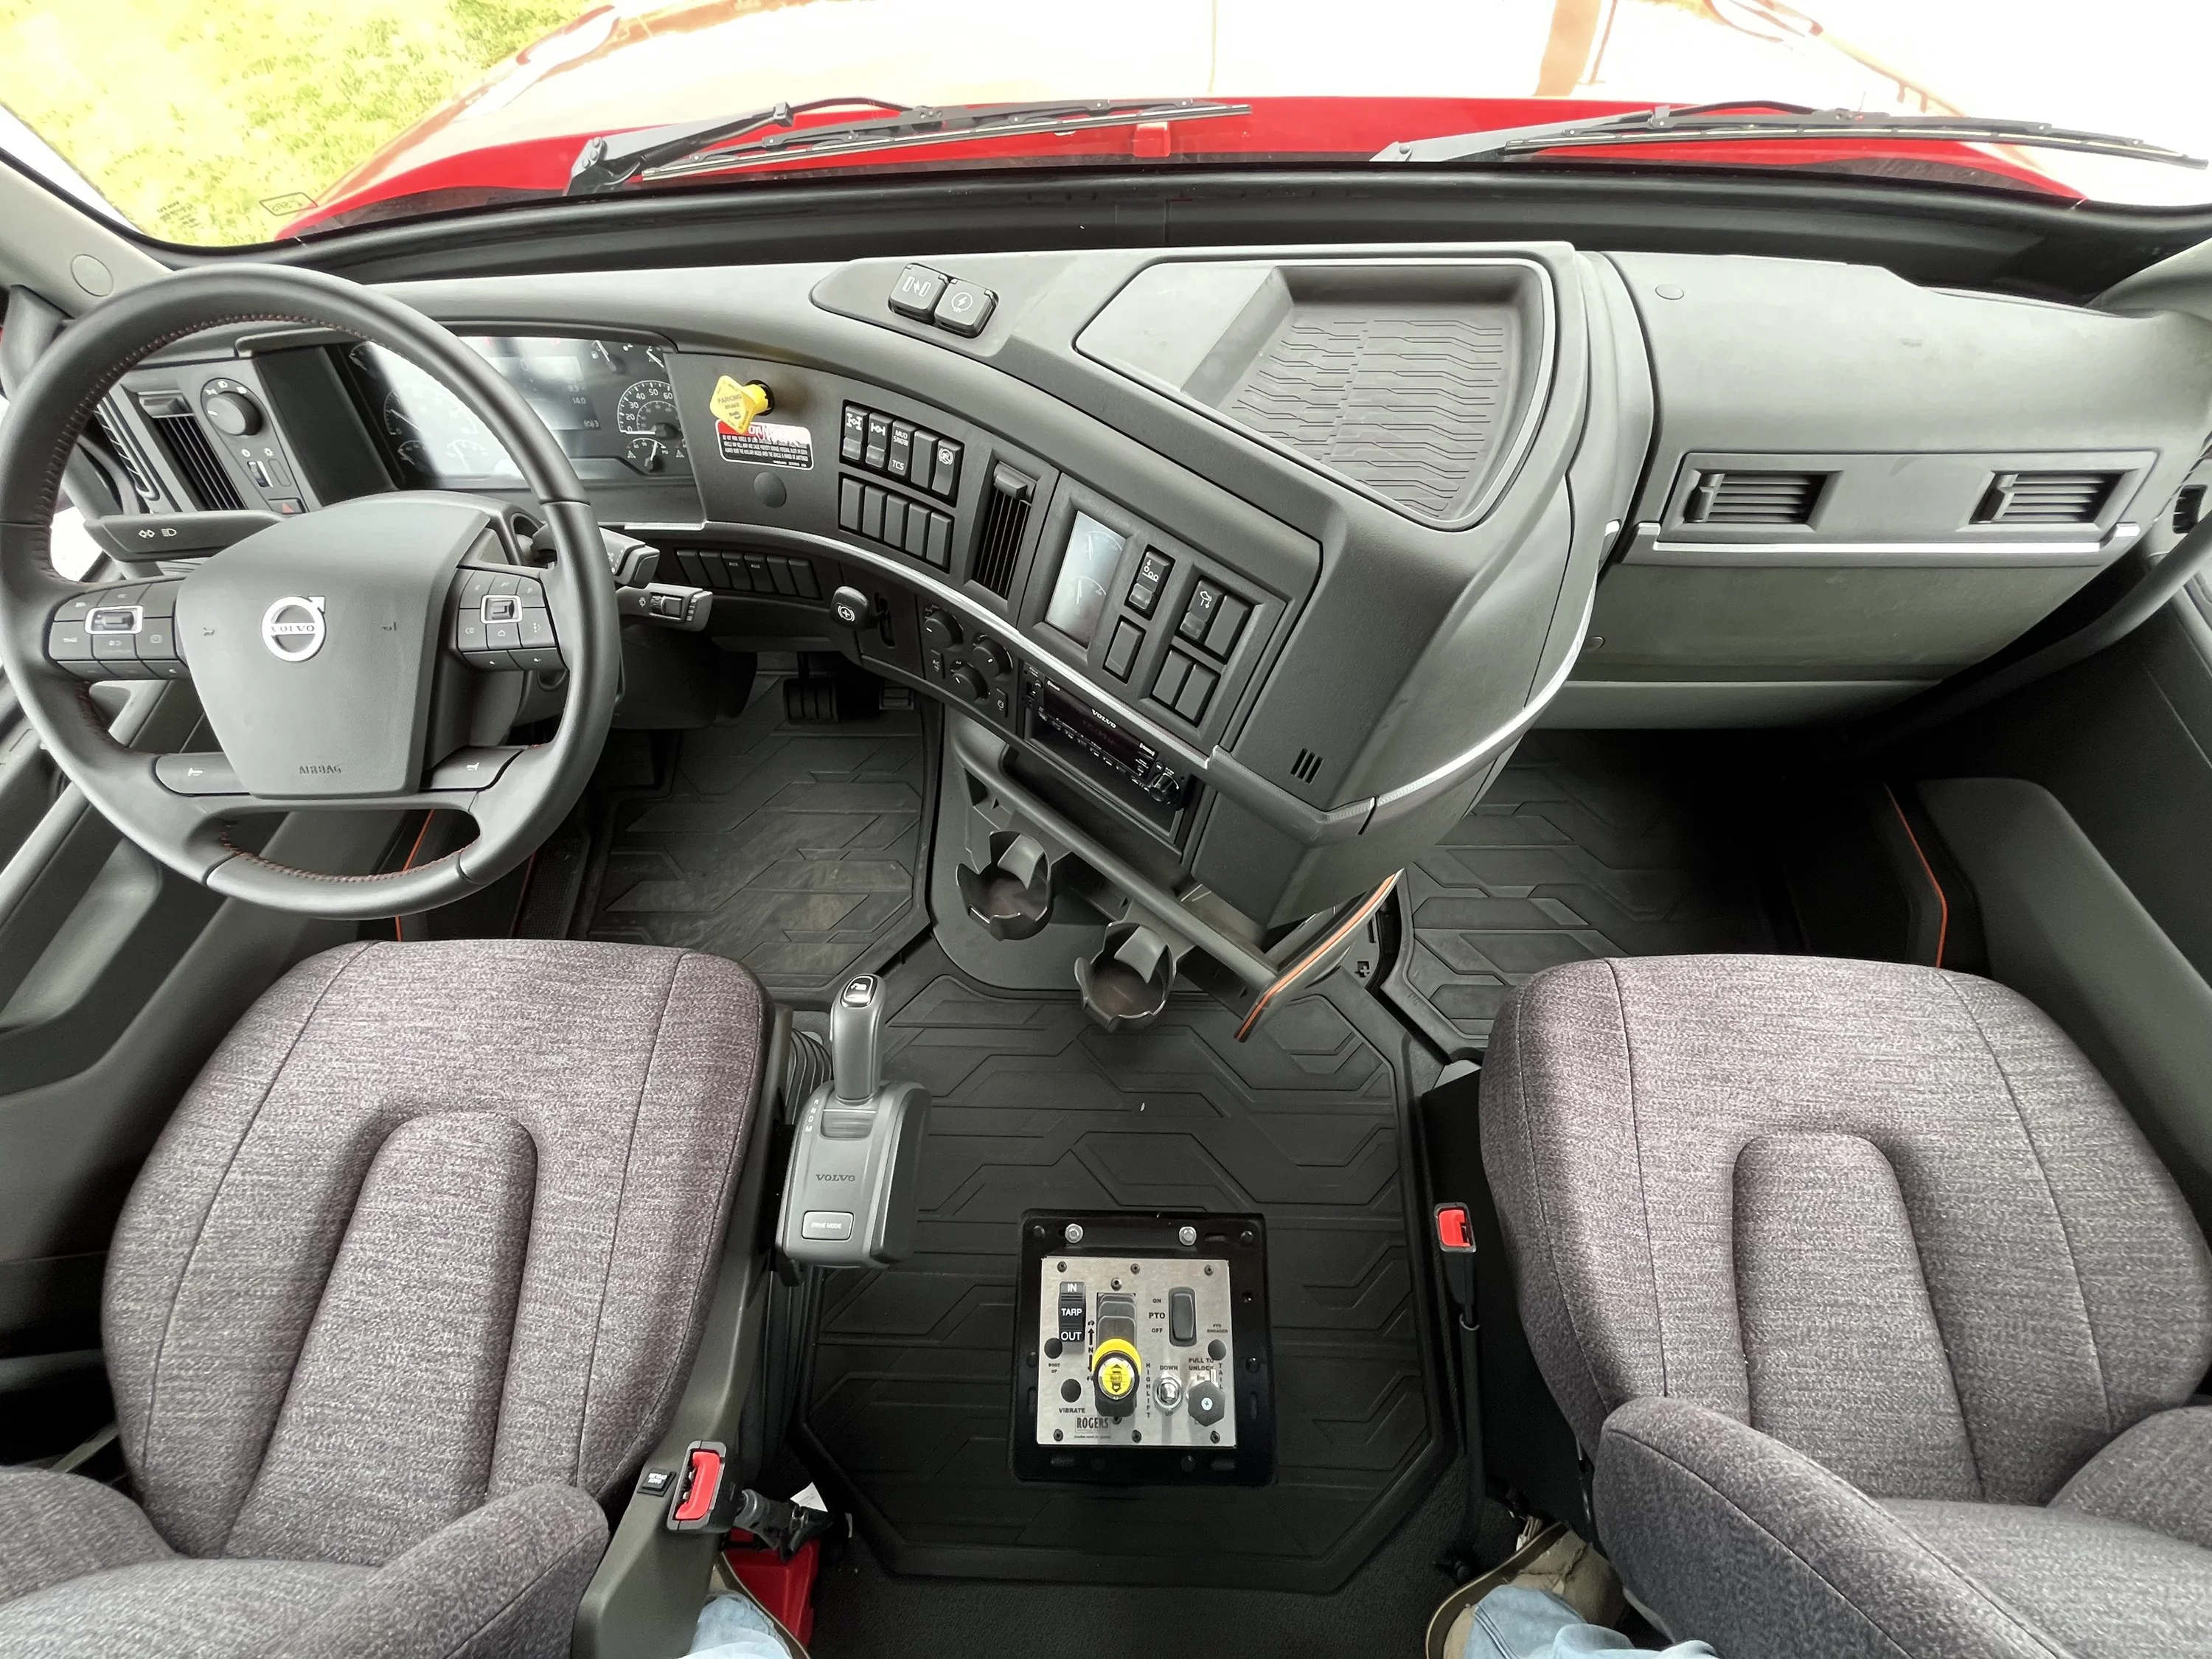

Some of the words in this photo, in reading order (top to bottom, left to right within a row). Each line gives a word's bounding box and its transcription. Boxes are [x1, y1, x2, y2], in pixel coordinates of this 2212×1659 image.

[636, 392, 646, 400] 40
[717, 394, 742, 404] PARKING
[629, 401, 639, 409] 30
[625, 413, 635, 421] 20
[894, 429, 908, 440] MUD
[893, 435, 909, 447] SNOW
[891, 459, 905, 470] TCS
[1091, 709, 1117, 728] VOLVO
[299, 764, 342, 774] AIRBAG
[815, 1173, 856, 1182] VOLVO
[1067, 1283, 1077, 1292] IN
[1061, 1308, 1082, 1316] TARP
[1060, 1332, 1082, 1340] OUT
[1077, 1417, 1109, 1429] ROGERS
